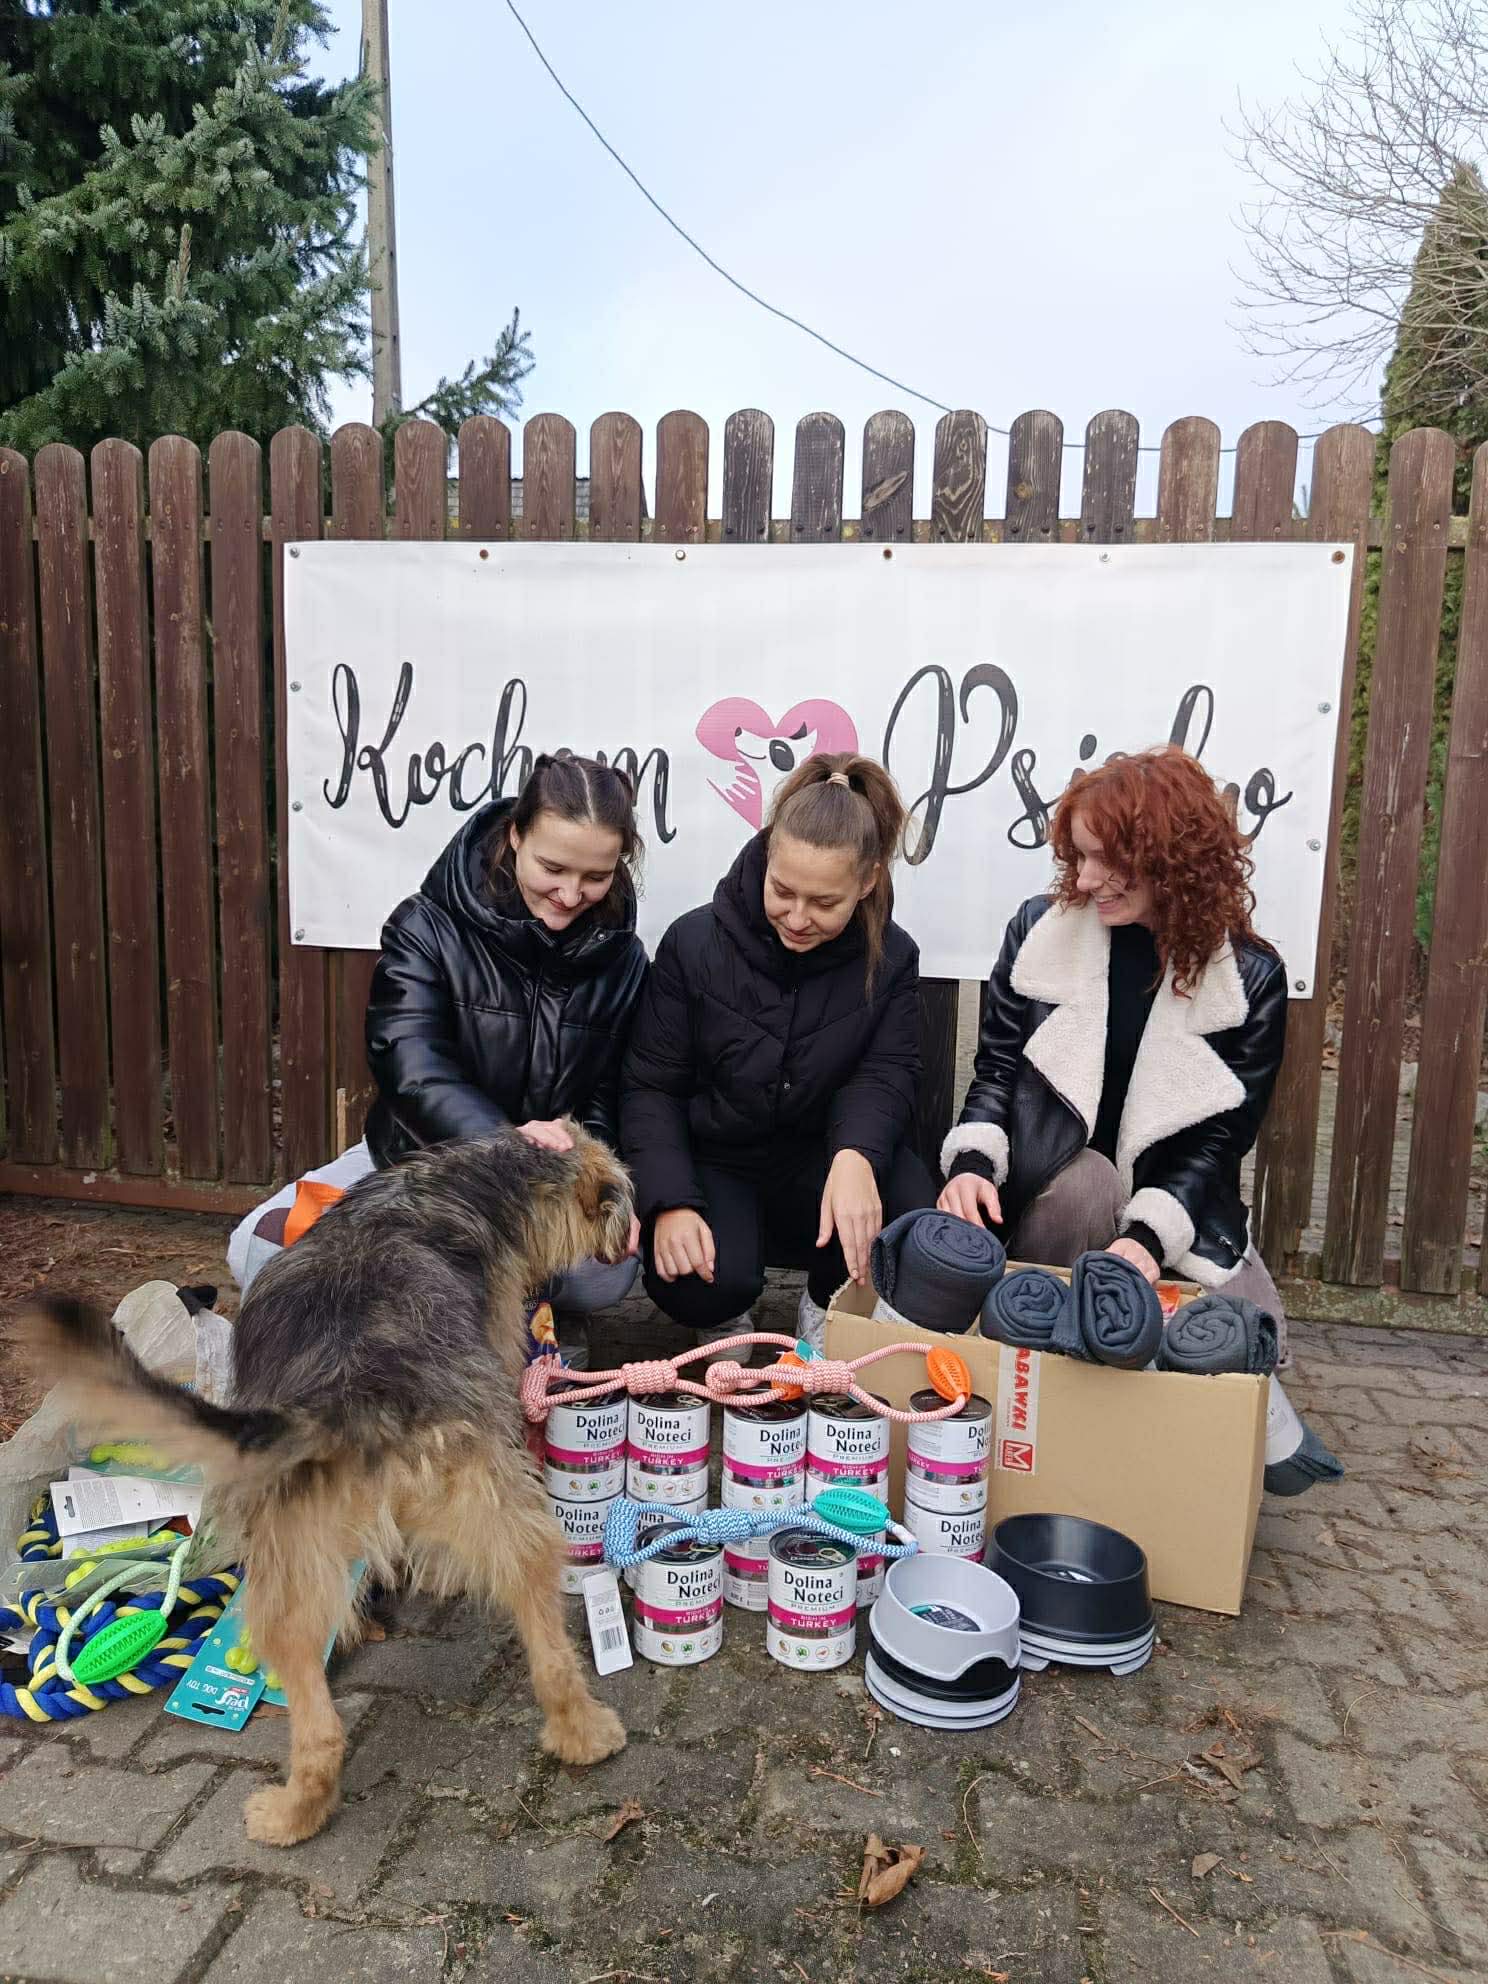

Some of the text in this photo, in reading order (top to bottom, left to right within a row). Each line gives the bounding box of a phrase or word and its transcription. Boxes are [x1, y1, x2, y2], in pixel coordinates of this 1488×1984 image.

[323, 661, 1293, 866] Kochm Psio
[1011, 1347, 1030, 1431] ABAWKI
[576, 1414, 619, 1428] Dolina
[637, 1412, 680, 1429] Dolina
[645, 1427, 692, 1442] Noteci
[827, 1424, 872, 1440] Dolina
[770, 1440, 804, 1455] Note
[836, 1437, 881, 1453] Noteci
[643, 1455, 684, 1466] TURKEY
[832, 1467, 875, 1476] TURKEY
[555, 1500, 600, 1520] Dolina
[564, 1519, 606, 1534] Notec
[941, 1520, 981, 1533] Dolina
[567, 1547, 602, 1557] URKEY
[667, 1568, 713, 1585] Dolina
[784, 1570, 833, 1589] Dolina
[679, 1573, 721, 1598] Noteci
[793, 1585, 843, 1603] Noteci
[675, 1606, 717, 1624] TURKEY
[790, 1618, 837, 1628] TURKEY
[186, 1679, 201, 1690] TOY
[202, 1683, 219, 1696] DOG
